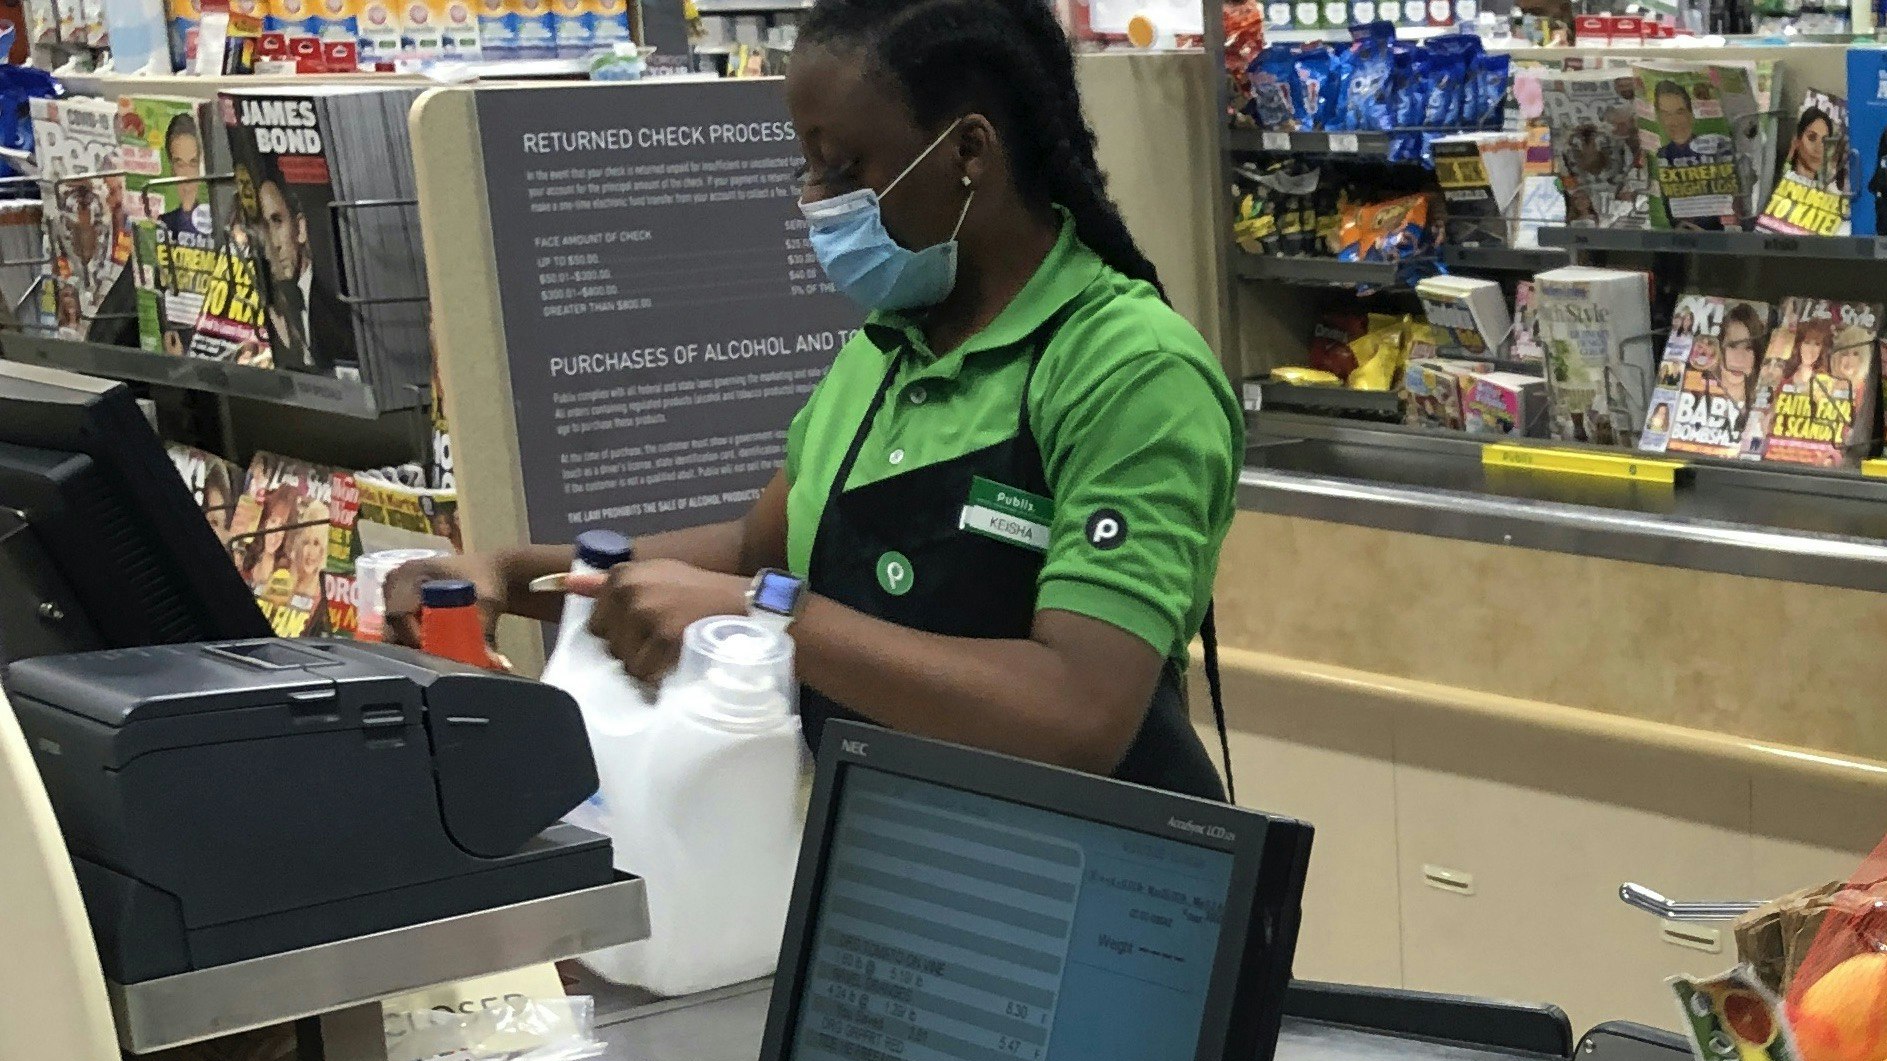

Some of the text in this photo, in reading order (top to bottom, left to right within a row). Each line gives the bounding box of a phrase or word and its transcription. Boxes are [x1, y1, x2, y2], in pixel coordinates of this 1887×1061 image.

[240, 100, 317, 128] JAMES
[254, 128, 322, 155] BOND
[523, 122, 796, 153] RETURNED CHECK PROCESS
[1764, 195, 1788, 218] TO
[534, 230, 652, 248] FACE AMOUNT OF CHECK
[537, 256, 551, 268] UP
[553, 254, 565, 266] TO
[550, 346, 668, 377] PURCHASES
[674, 344, 698, 365] OF
[704, 336, 790, 361] ALCOHOL
[795, 331, 834, 352] AND
[1676, 392, 1746, 434] BABY
[996, 491, 1036, 513] Publix
[989, 514, 1034, 541] KEISHA
[841, 738, 870, 757] NEC
